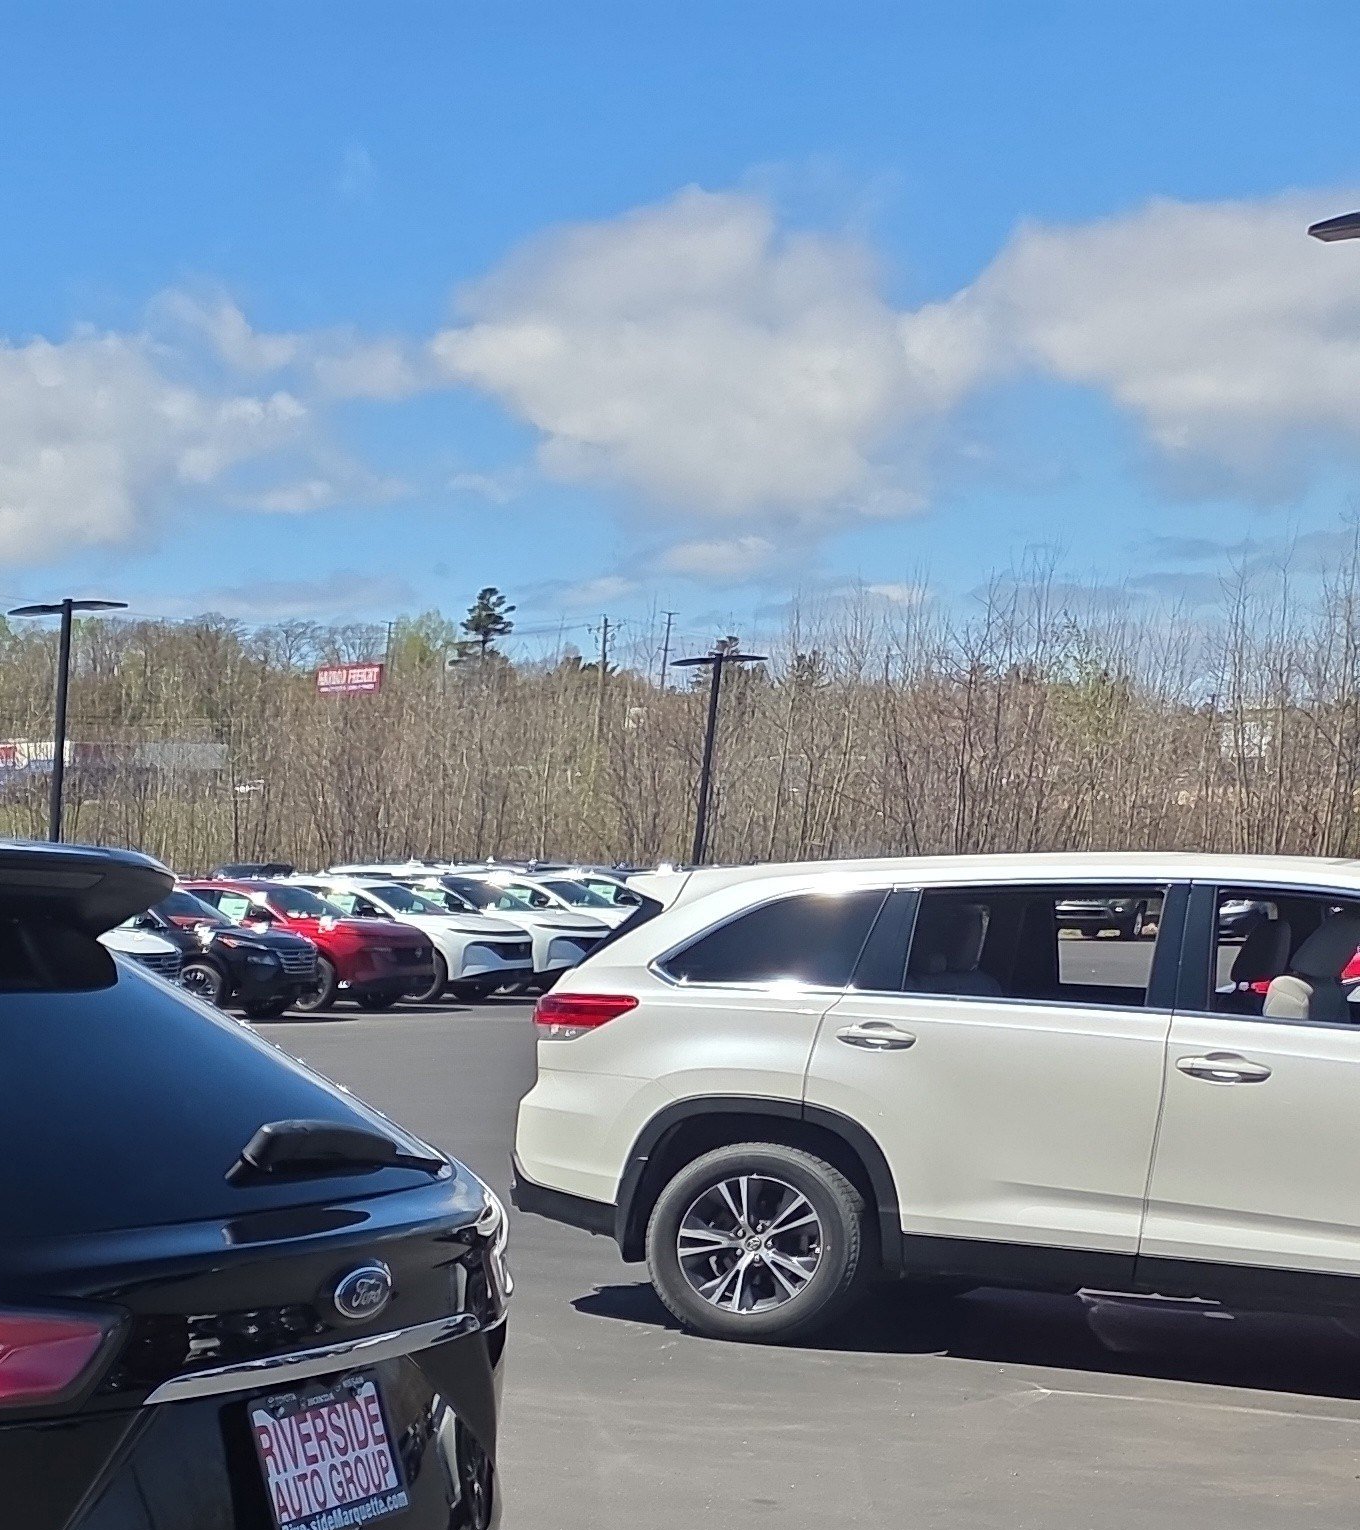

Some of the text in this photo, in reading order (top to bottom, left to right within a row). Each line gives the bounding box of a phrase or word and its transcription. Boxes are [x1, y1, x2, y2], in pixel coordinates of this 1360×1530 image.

[252, 1394, 386, 1476] RIVERSIDE
[275, 1449, 389, 1523] AUTO GROUP
